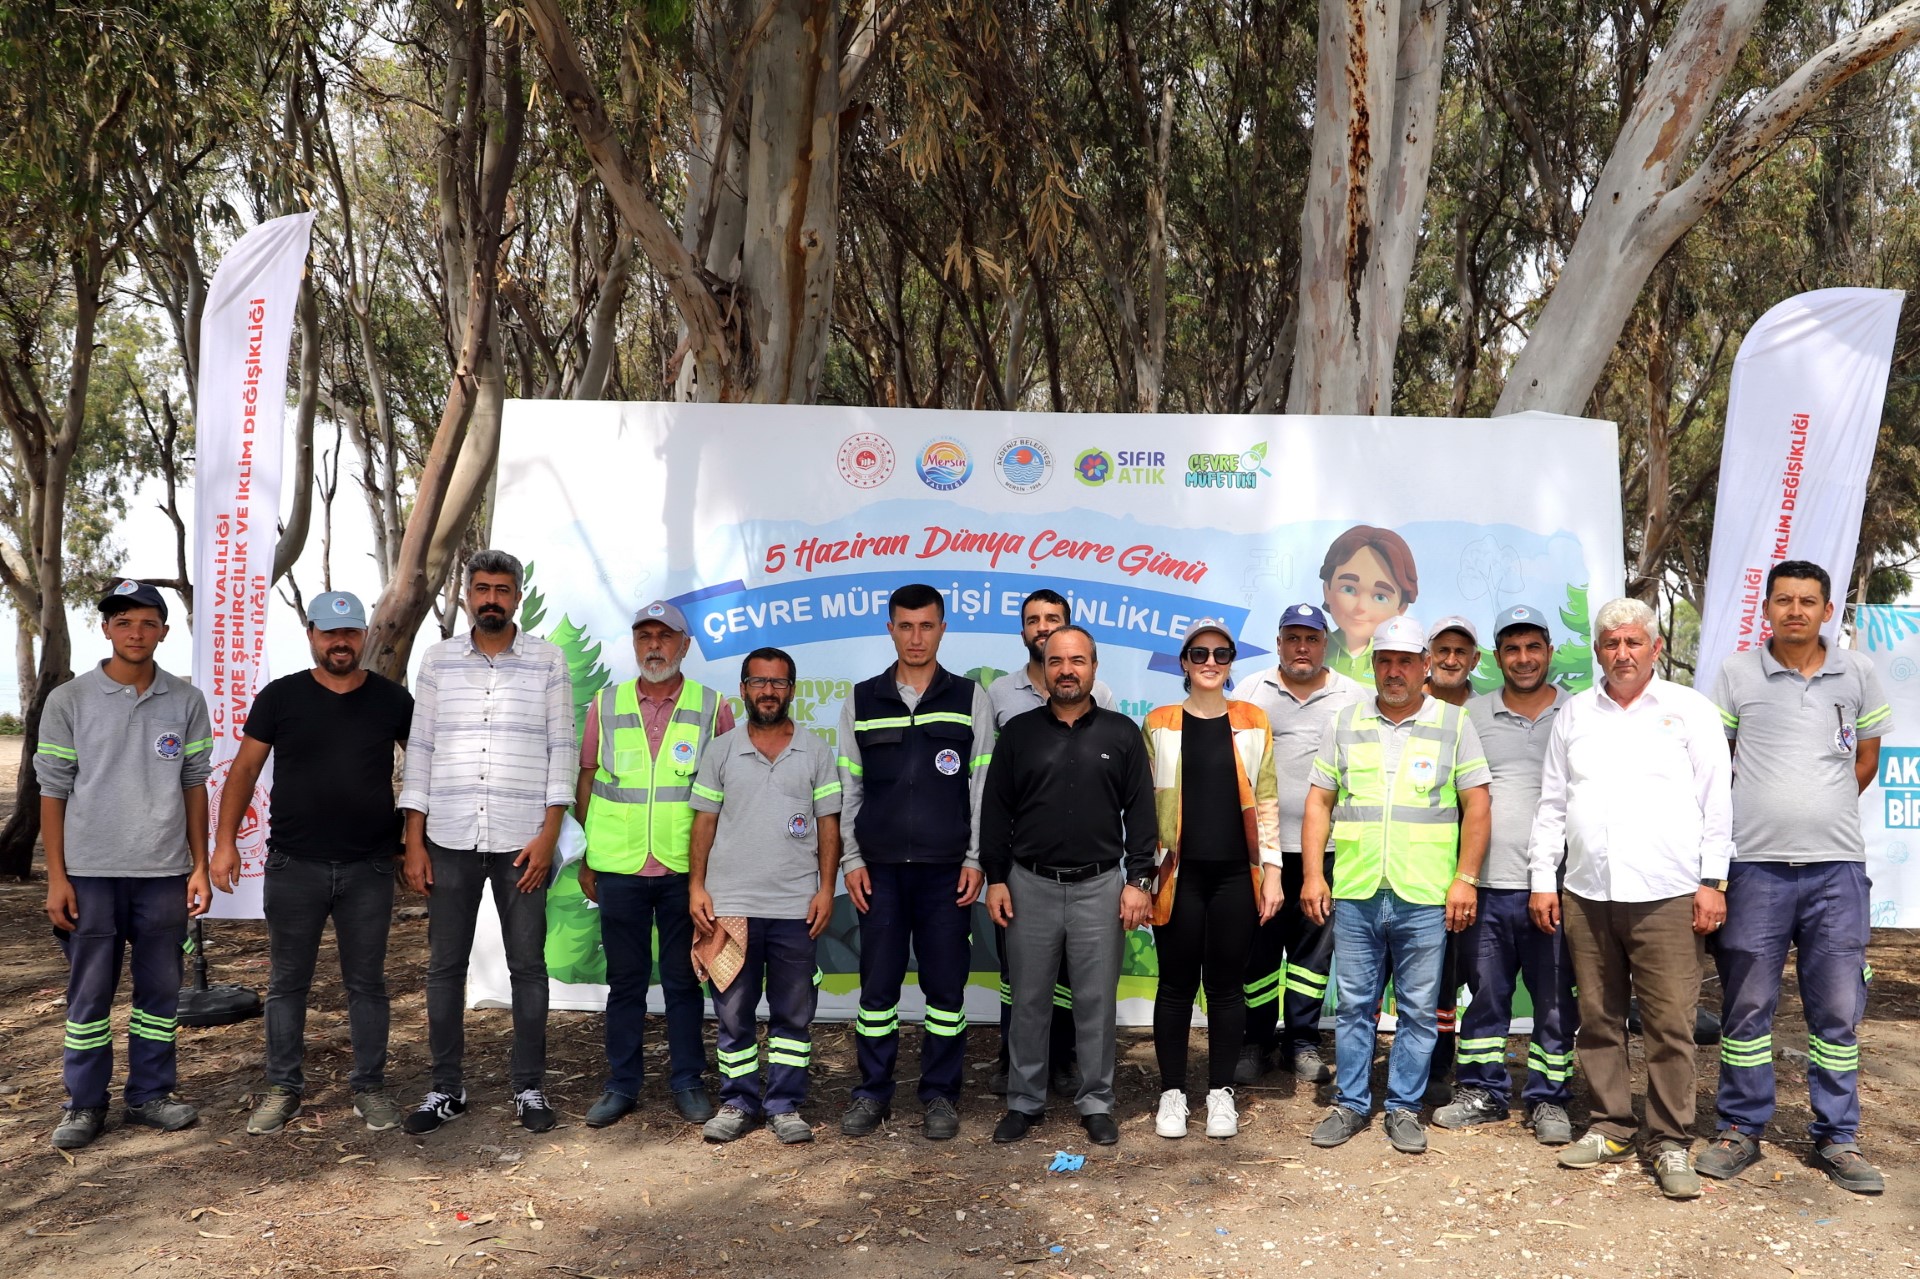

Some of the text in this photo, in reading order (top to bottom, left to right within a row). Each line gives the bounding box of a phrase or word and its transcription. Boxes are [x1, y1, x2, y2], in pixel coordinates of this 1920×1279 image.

[243, 298, 266, 434] DEĞİŞİKLİĞİ
[235, 440, 253, 501] İKLİM
[996, 440, 1018, 466] AKDENİZ
[1020, 439, 1051, 467] BELEDİYESİ
[1117, 451, 1166, 467] SIFIR
[1117, 467, 1166, 485] ATIK
[1770, 412, 1810, 560] İKLİM DEĞİŞİKLİĞİ
[235, 507, 249, 535] VE
[764, 525, 1209, 584] 5 Haziran Dünya Çevre Günü
[212, 513, 230, 740] T.C. MERSİN VALİLİĞİ
[229, 540, 250, 664] ŞEHİRCİLİK
[703, 581, 1225, 644] ÇEVRE MÜFİŞİ EİNLİKLE
[1739, 567, 1763, 636] VALİLİĞİ
[796, 679, 852, 705] nya
[1119, 699, 1154, 716] tık
